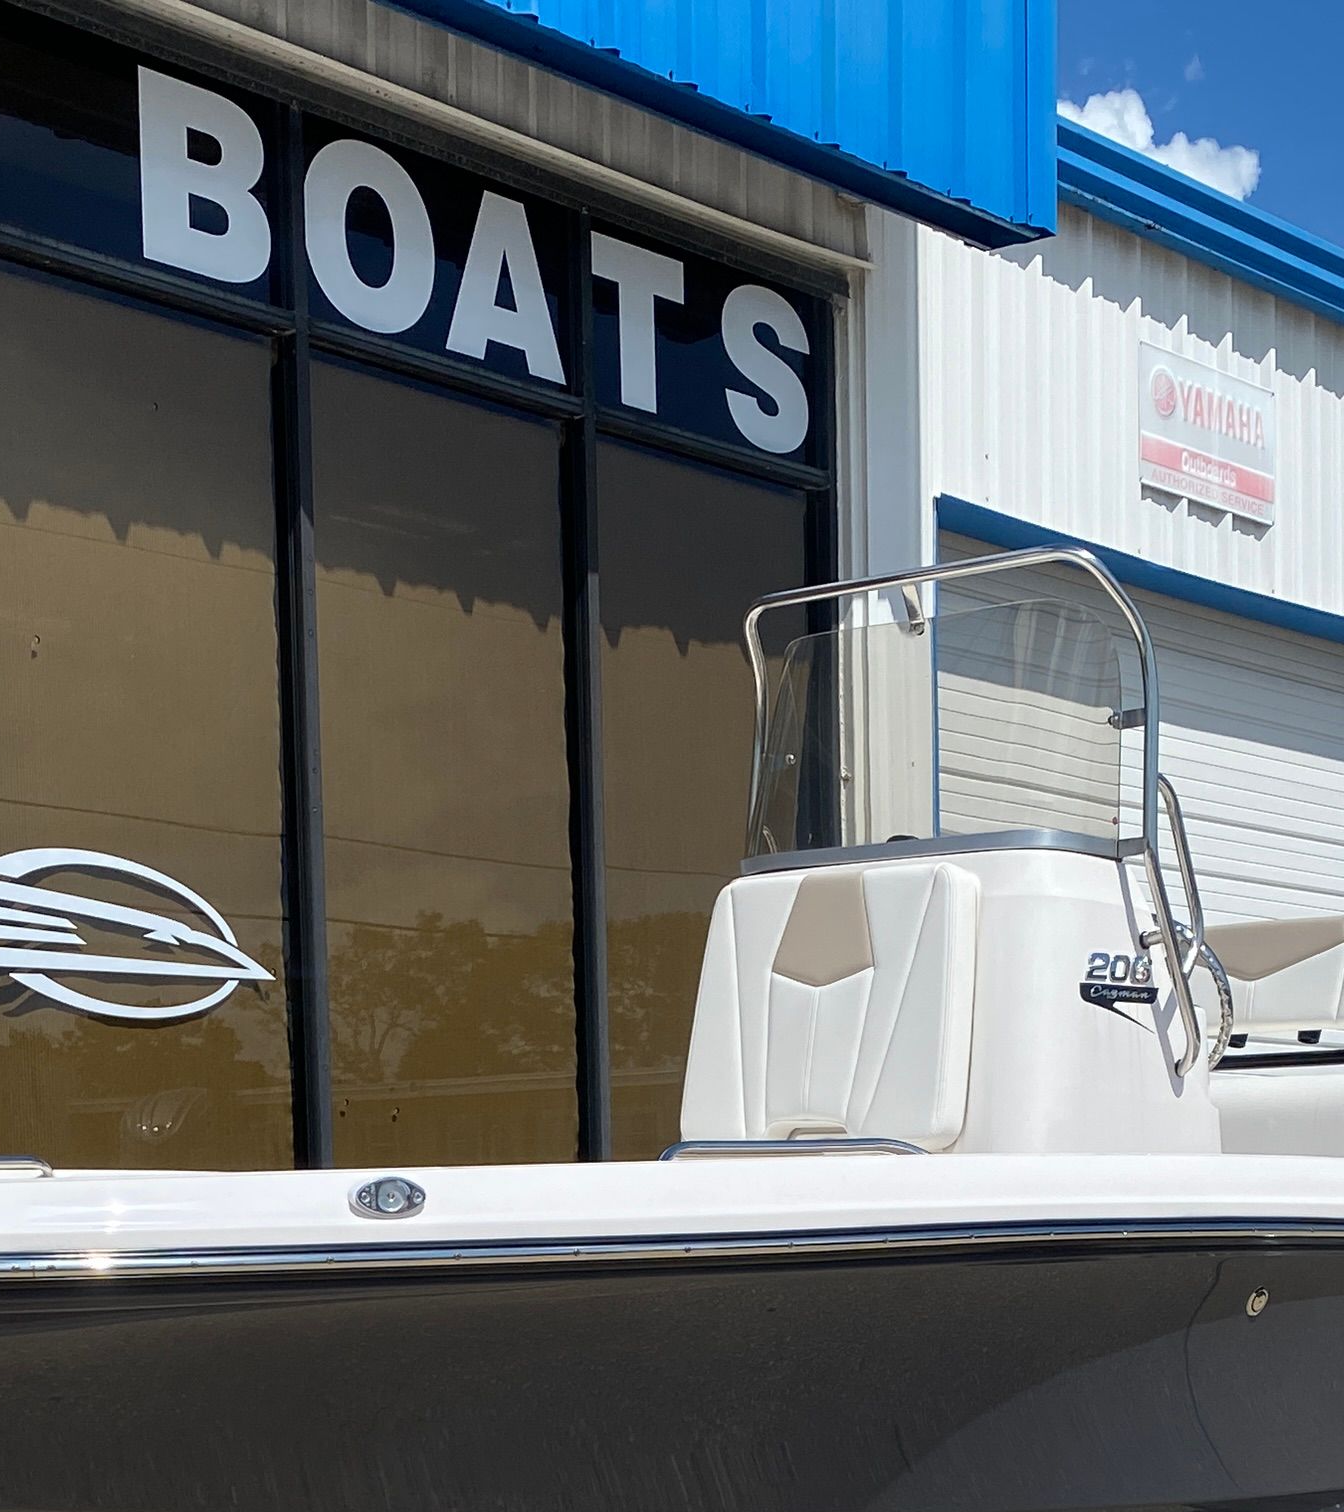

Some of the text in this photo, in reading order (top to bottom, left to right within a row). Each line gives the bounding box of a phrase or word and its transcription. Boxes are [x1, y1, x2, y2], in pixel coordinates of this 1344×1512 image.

[137, 65, 811, 455] BOATS
[1178, 379, 1265, 450] YAMAHA
[1221, 491, 1265, 515] SERVICE
[1090, 985, 1151, 999] Cayman
